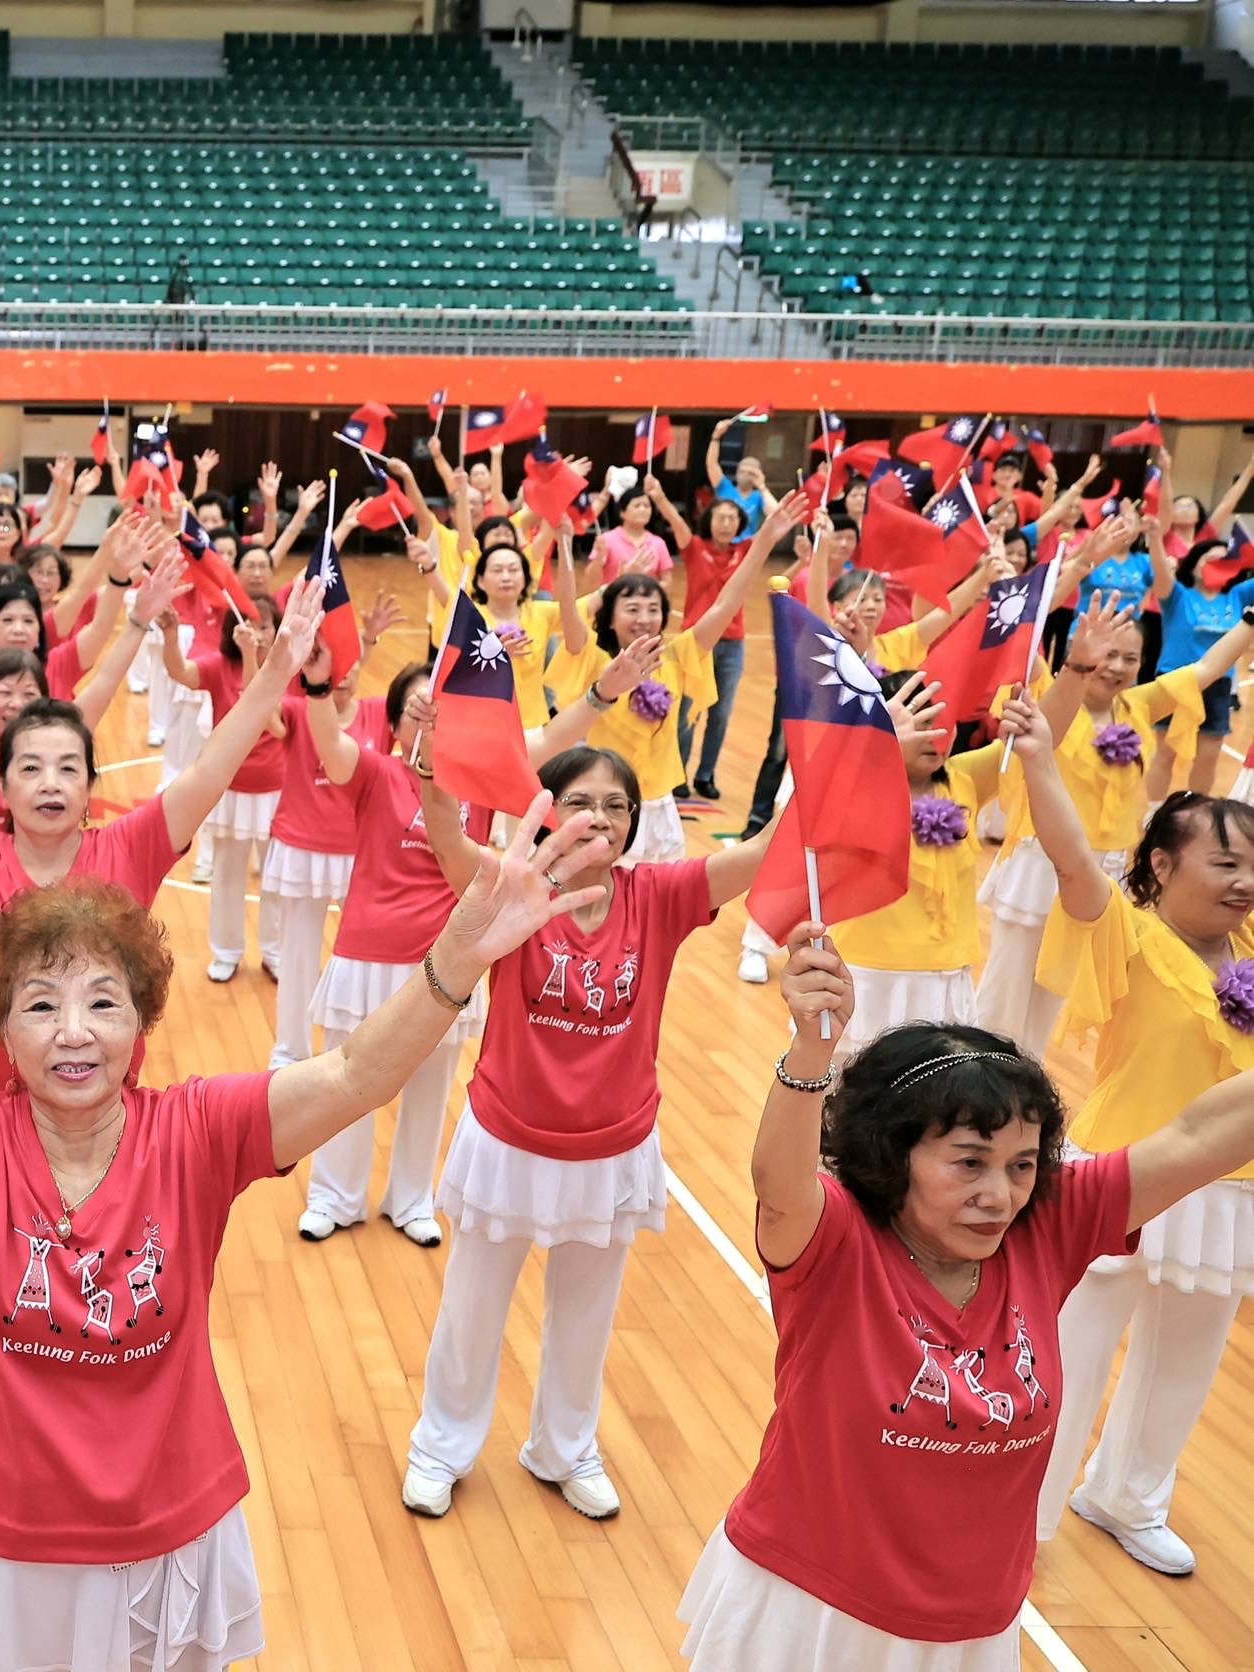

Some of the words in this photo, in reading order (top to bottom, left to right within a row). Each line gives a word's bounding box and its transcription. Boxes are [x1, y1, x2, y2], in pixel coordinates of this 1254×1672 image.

[528, 1012, 575, 1032] Keelung
[575, 1023, 601, 1036] Folk
[1, 1336, 75, 1363] Keelung
[78, 1350, 118, 1365] Folk
[123, 1330, 172, 1363] Dance
[881, 1428, 962, 1454] Keelung
[963, 1441, 1000, 1455] Folk
